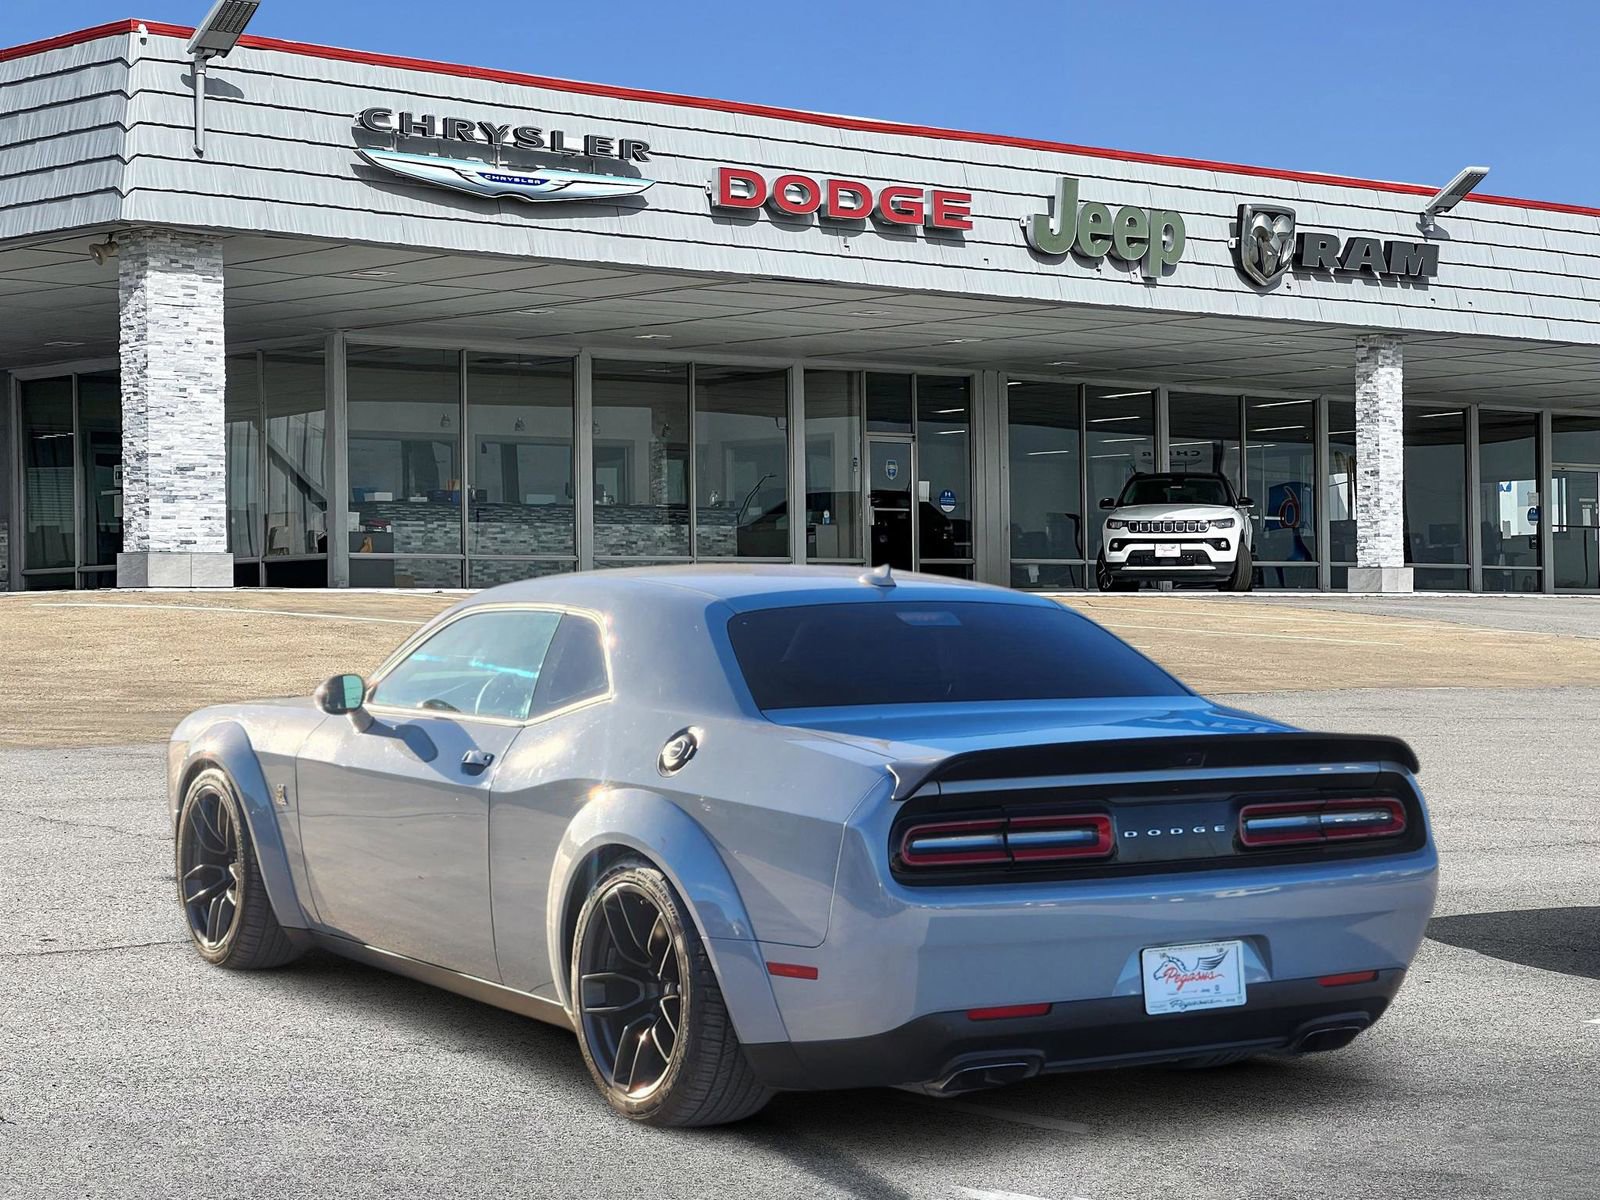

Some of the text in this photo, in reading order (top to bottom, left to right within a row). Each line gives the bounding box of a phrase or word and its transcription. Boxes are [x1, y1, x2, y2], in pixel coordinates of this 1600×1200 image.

[359, 106, 651, 163] CHRYSLER
[484, 174, 541, 185] CHRYSLER
[712, 167, 973, 230] DODGE
[1027, 177, 1186, 278] Jeep
[1301, 232, 1440, 277] RAM
[1124, 825, 1225, 838] DODGE
[1163, 966, 1224, 991] Pegasus
